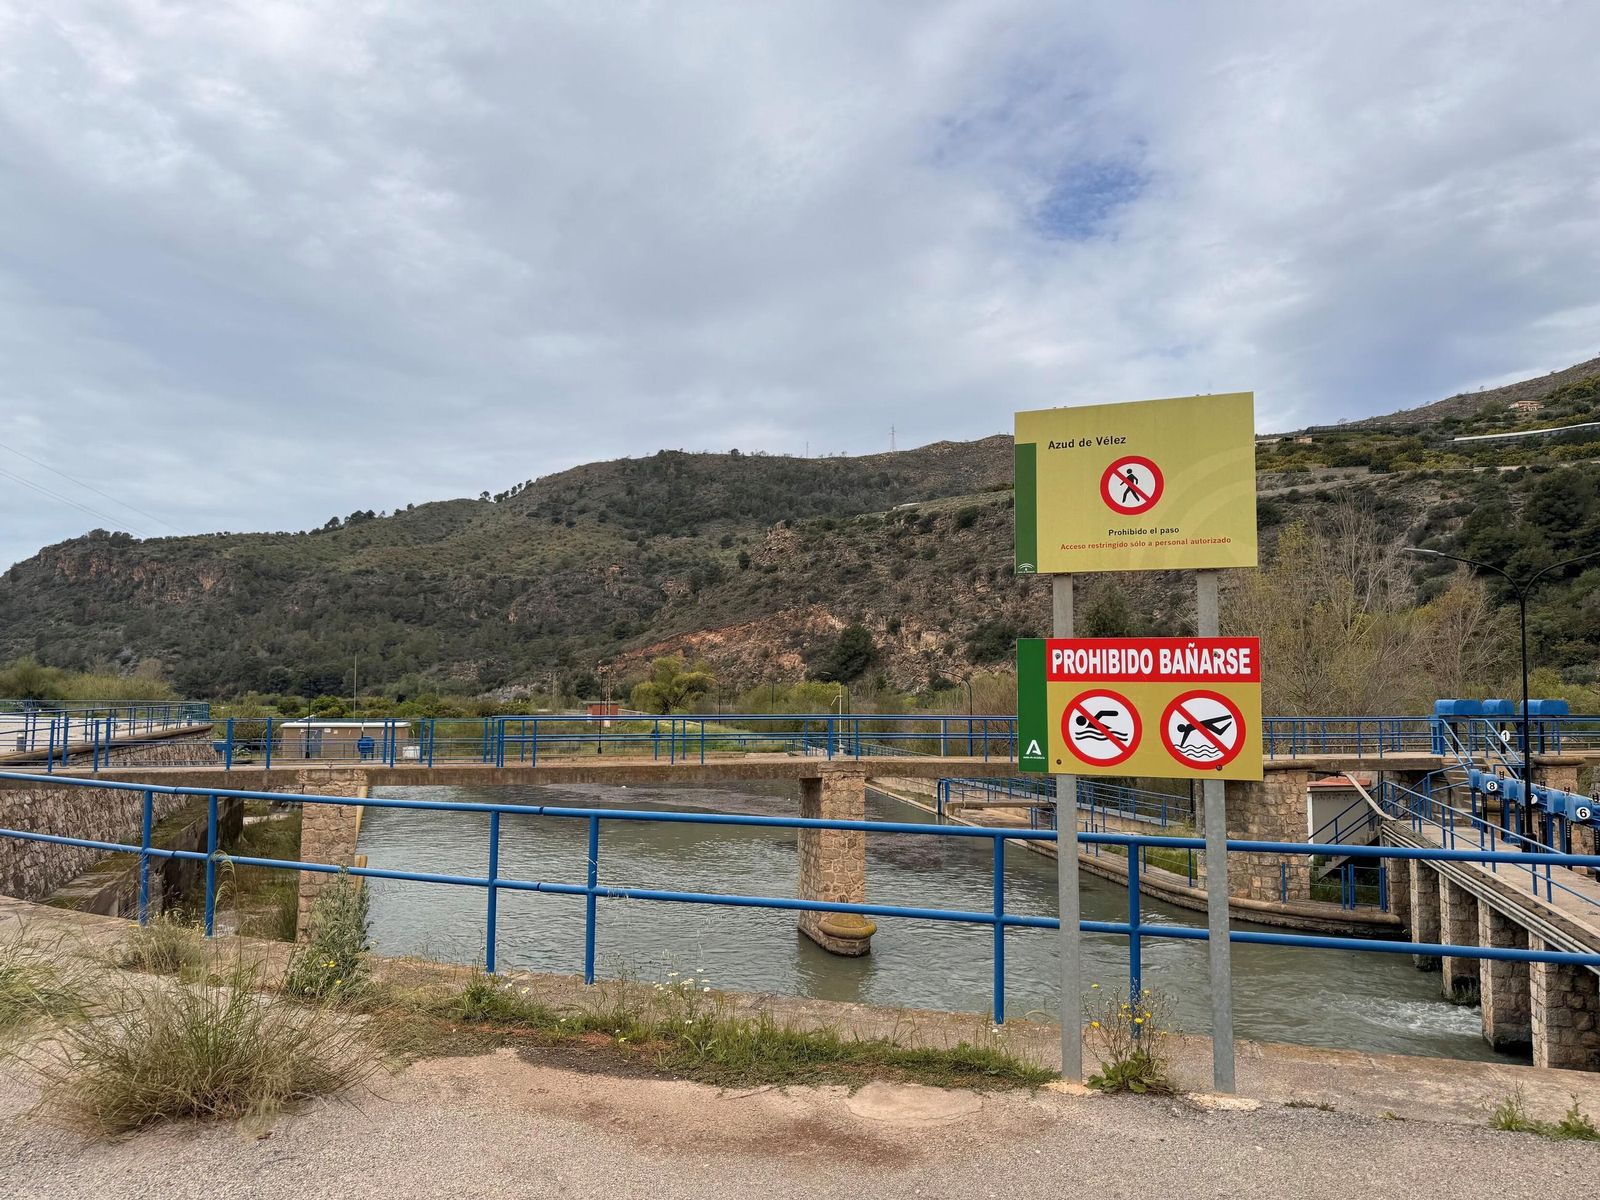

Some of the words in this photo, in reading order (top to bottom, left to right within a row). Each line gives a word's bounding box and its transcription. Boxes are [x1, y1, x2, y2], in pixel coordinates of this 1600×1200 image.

[1048, 439, 1075, 450] Azud
[1079, 438, 1092, 447] de
[1096, 434, 1126, 446] Vélez
[1108, 528, 1148, 536] Prohibido
[1149, 527, 1158, 535] el
[1160, 527, 1180, 535] paso
[1060, 543, 1086, 551] Acceso
[1088, 541, 1128, 549] restringido
[1155, 538, 1188, 547] personal
[1190, 537, 1232, 545] autorizado
[1052, 649, 1153, 674] PROHIBIDO
[1159, 642, 1251, 674] BAÑARSE
[1489, 782, 1495, 790] 8
[1579, 808, 1587, 818] 6
